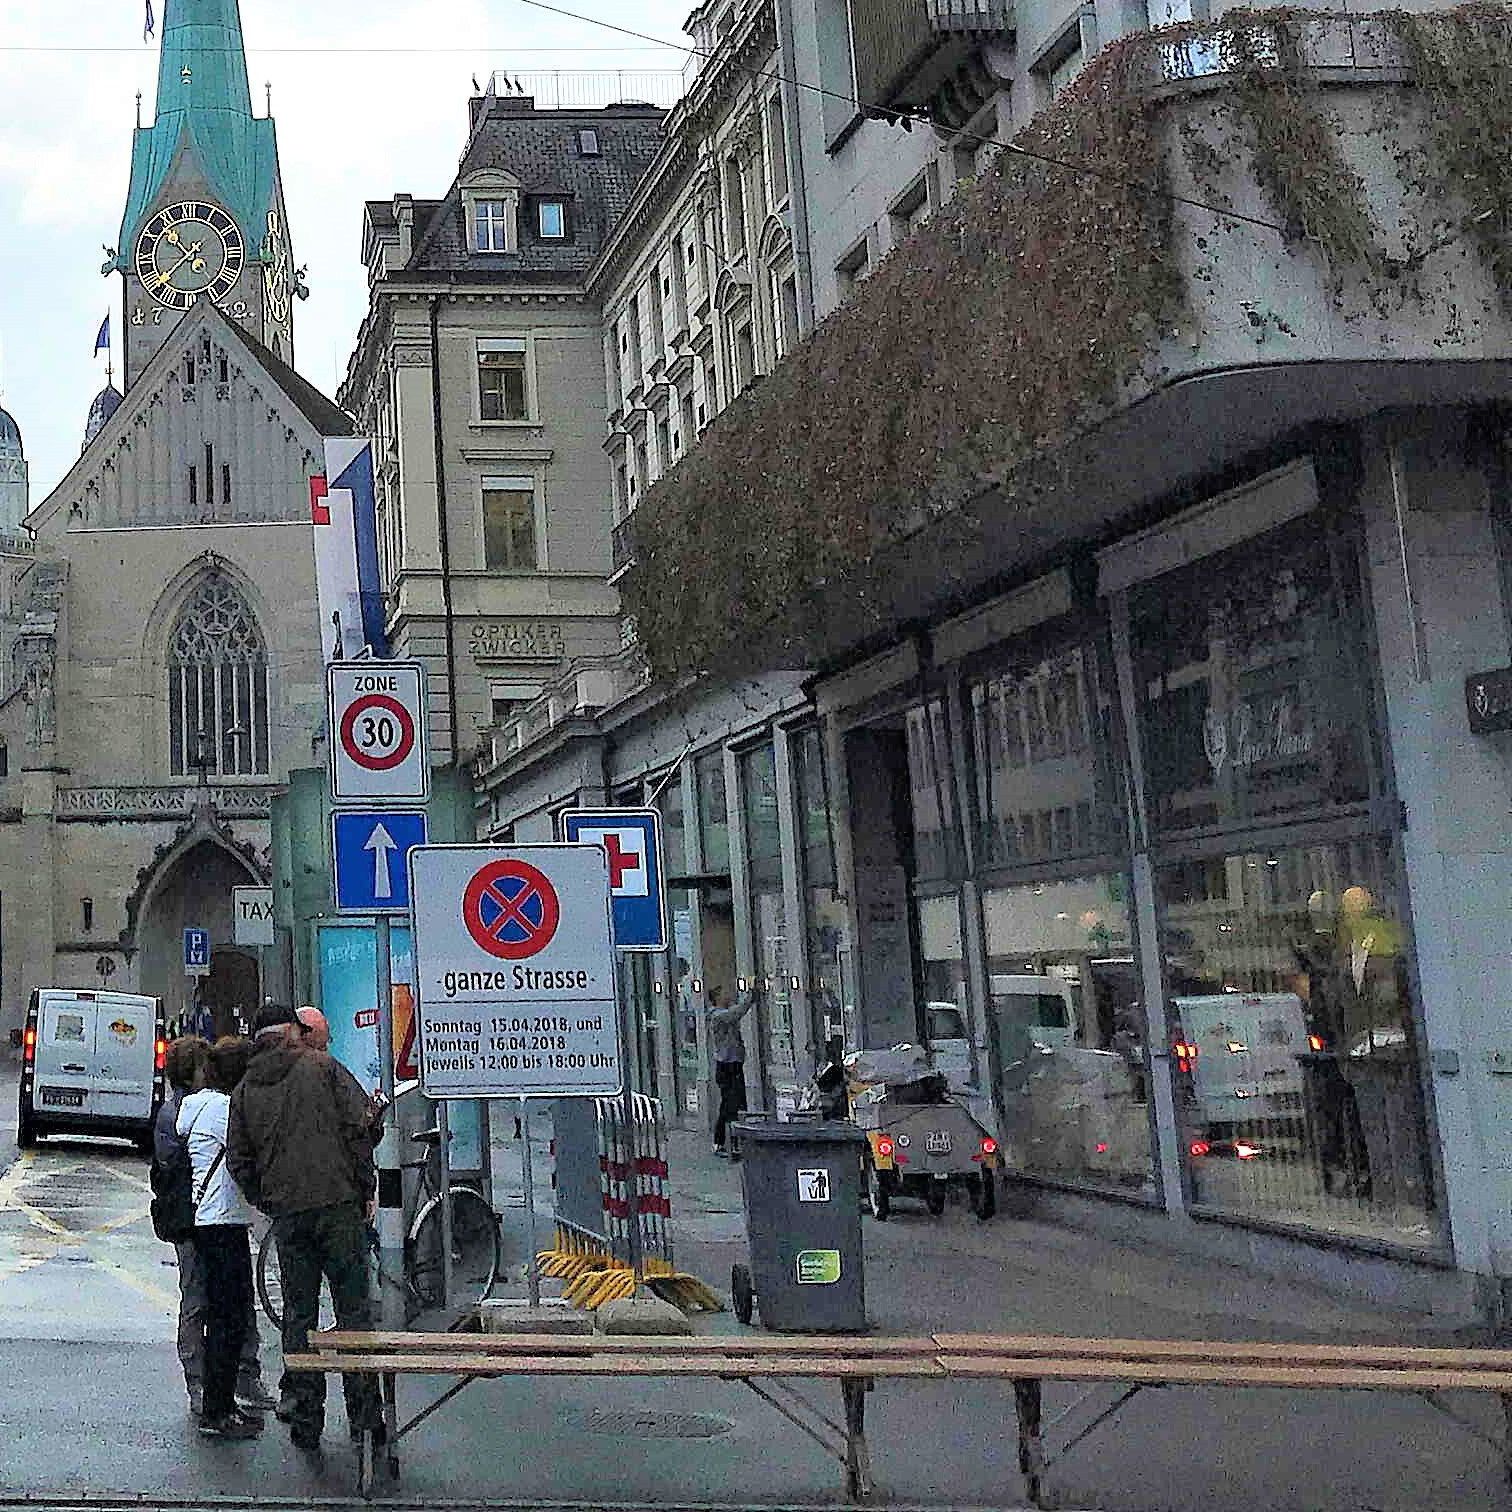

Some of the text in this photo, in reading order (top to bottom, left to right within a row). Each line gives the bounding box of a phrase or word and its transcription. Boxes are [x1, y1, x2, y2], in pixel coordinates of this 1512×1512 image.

[471, 624, 561, 639] OPTIKER
[468, 638, 565, 655] ZWICKER
[354, 676, 398, 692] ZONE
[361, 717, 394, 748] 30
[444, 965, 588, 998] ganze Strasse
[424, 1019, 482, 1035] Sonntag
[576, 1016, 603, 1031] und
[425, 1036, 566, 1054] Montag 16.04.2018
[426, 1056, 475, 1074] jeweils
[522, 1054, 543, 1069] bis
[548, 1053, 586, 1068] 18:00
[590, 1053, 615, 1068] Uhr
